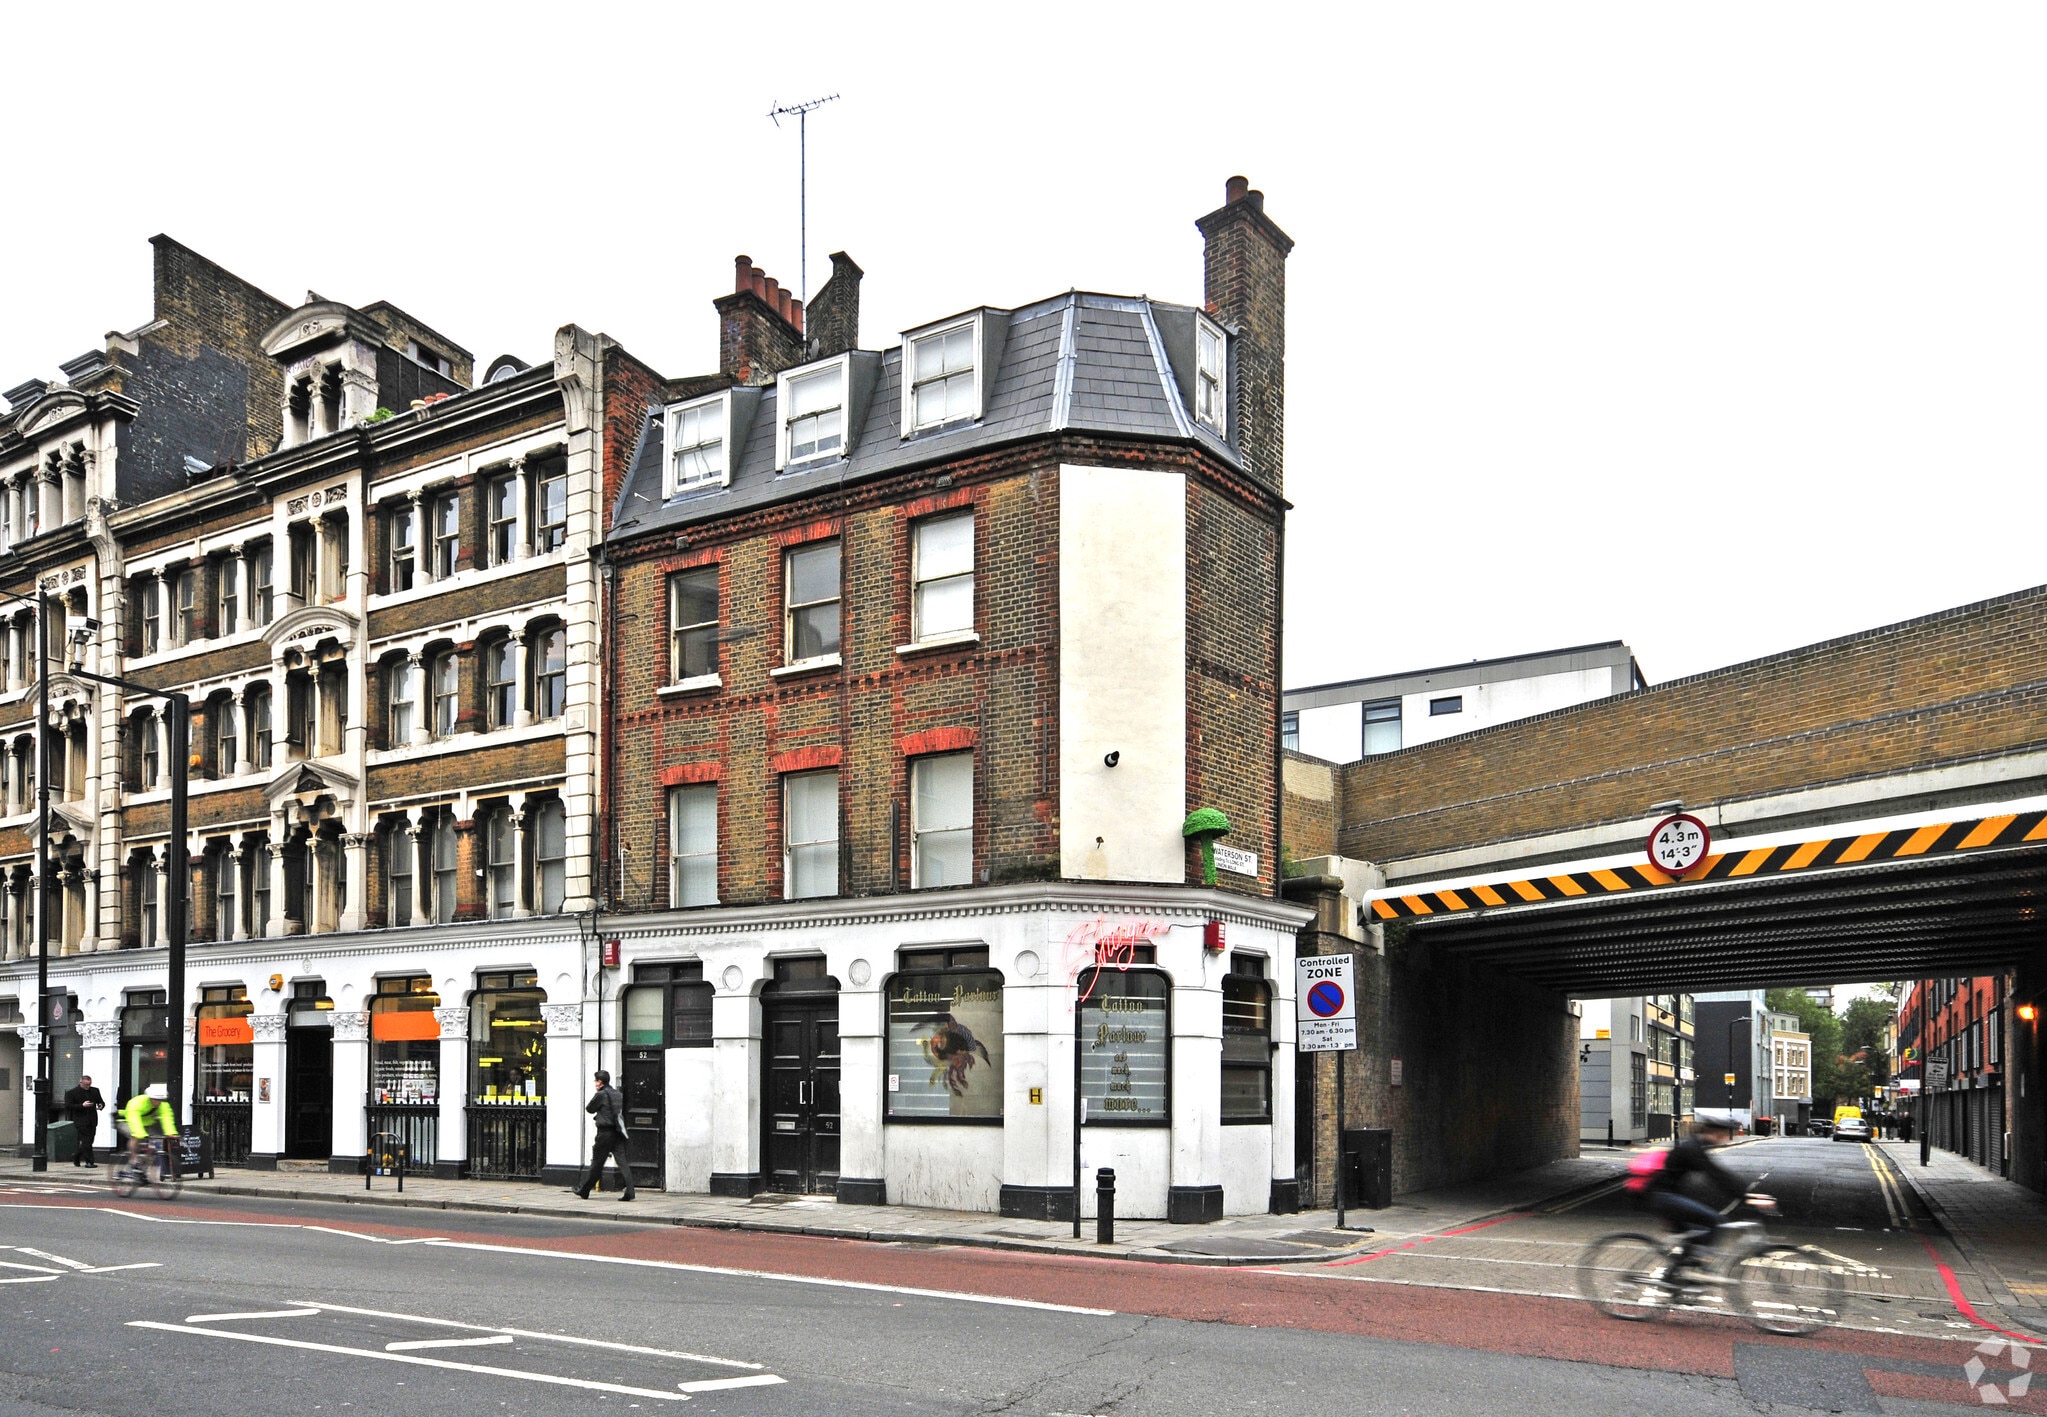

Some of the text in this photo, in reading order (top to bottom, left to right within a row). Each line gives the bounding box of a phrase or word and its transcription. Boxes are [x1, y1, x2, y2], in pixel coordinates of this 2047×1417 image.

[1300, 956, 1350, 967] Controlled
[1307, 968, 1342, 978] ZONE
[205, 1026, 240, 1039] The Grocery
[1095, 1022, 1147, 1048] Parlour
[1031, 1089, 1041, 1103] H
